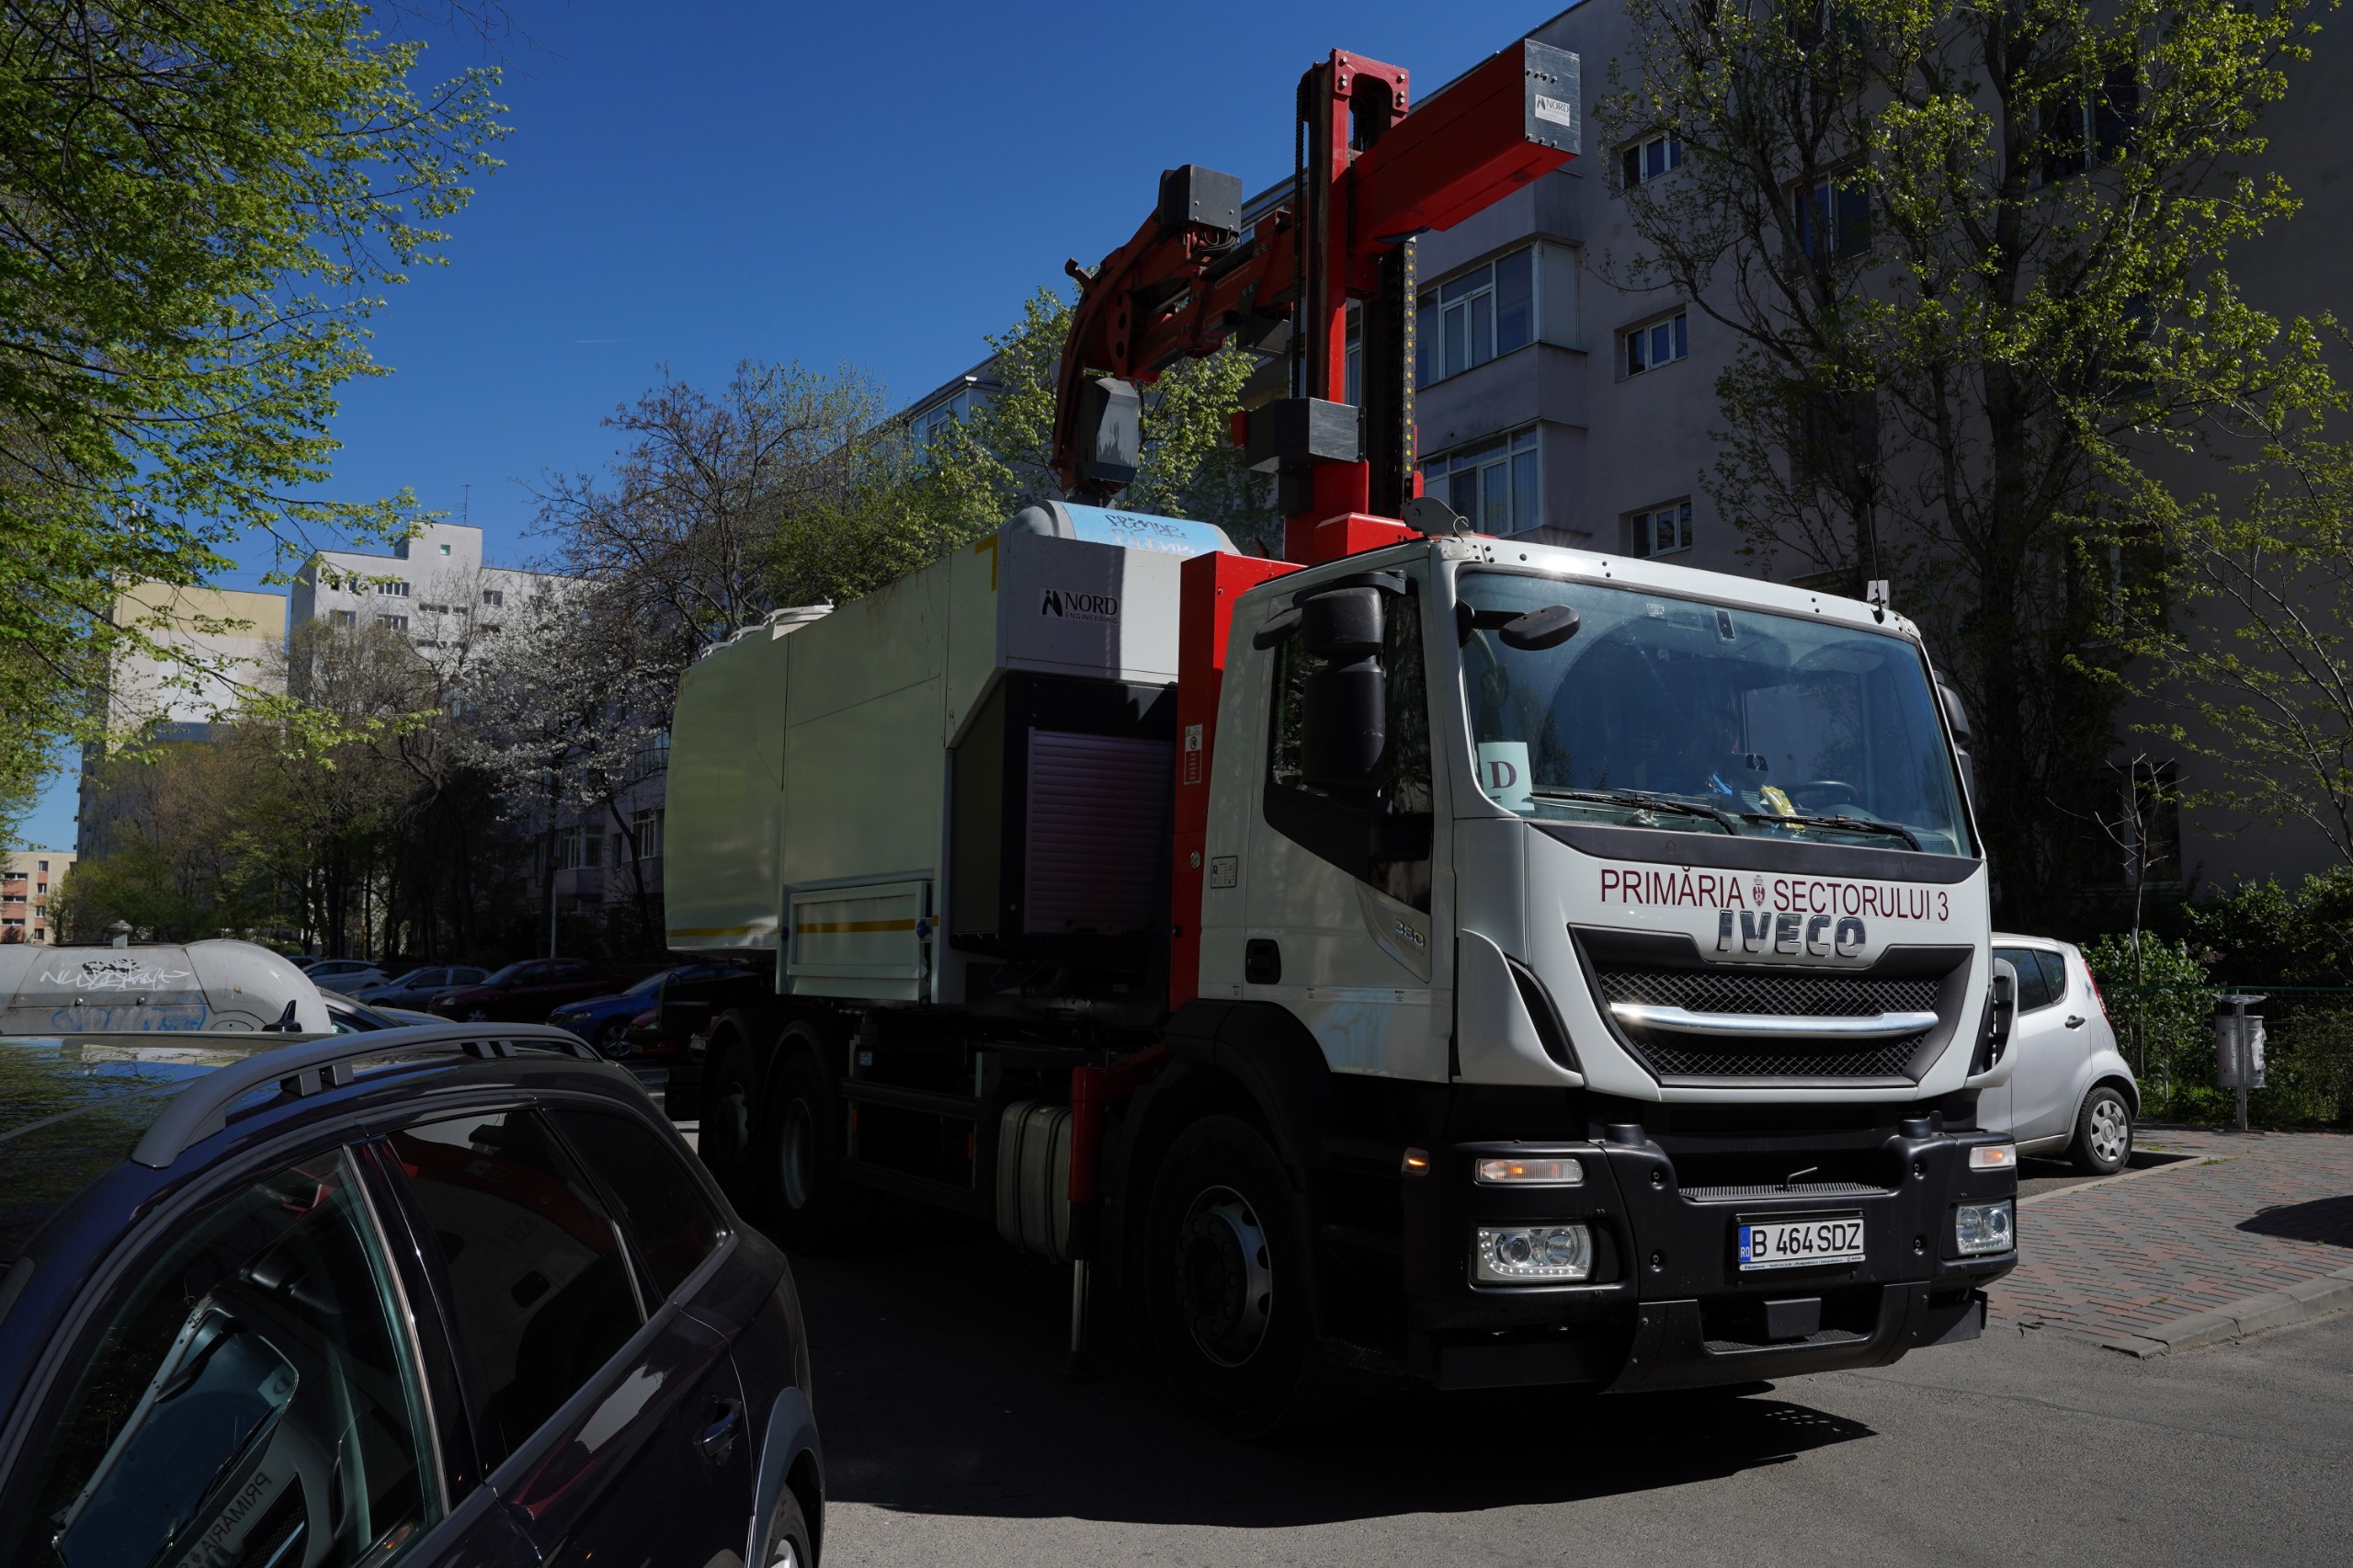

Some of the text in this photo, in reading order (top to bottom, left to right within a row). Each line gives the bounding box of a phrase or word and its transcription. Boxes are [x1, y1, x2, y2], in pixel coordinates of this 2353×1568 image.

[1546, 99, 1569, 112] NORD
[1064, 591, 1118, 615] NORD
[1064, 612, 1118, 624] ENGINEERING
[1487, 760, 1518, 790] D
[1601, 865, 1949, 922] PRIMĂRIA SECTORULUI 3
[1716, 909, 1866, 959] IVECO
[1740, 1246, 1750, 1258] RO
[1752, 1222, 1861, 1258] B 464 SDZ
